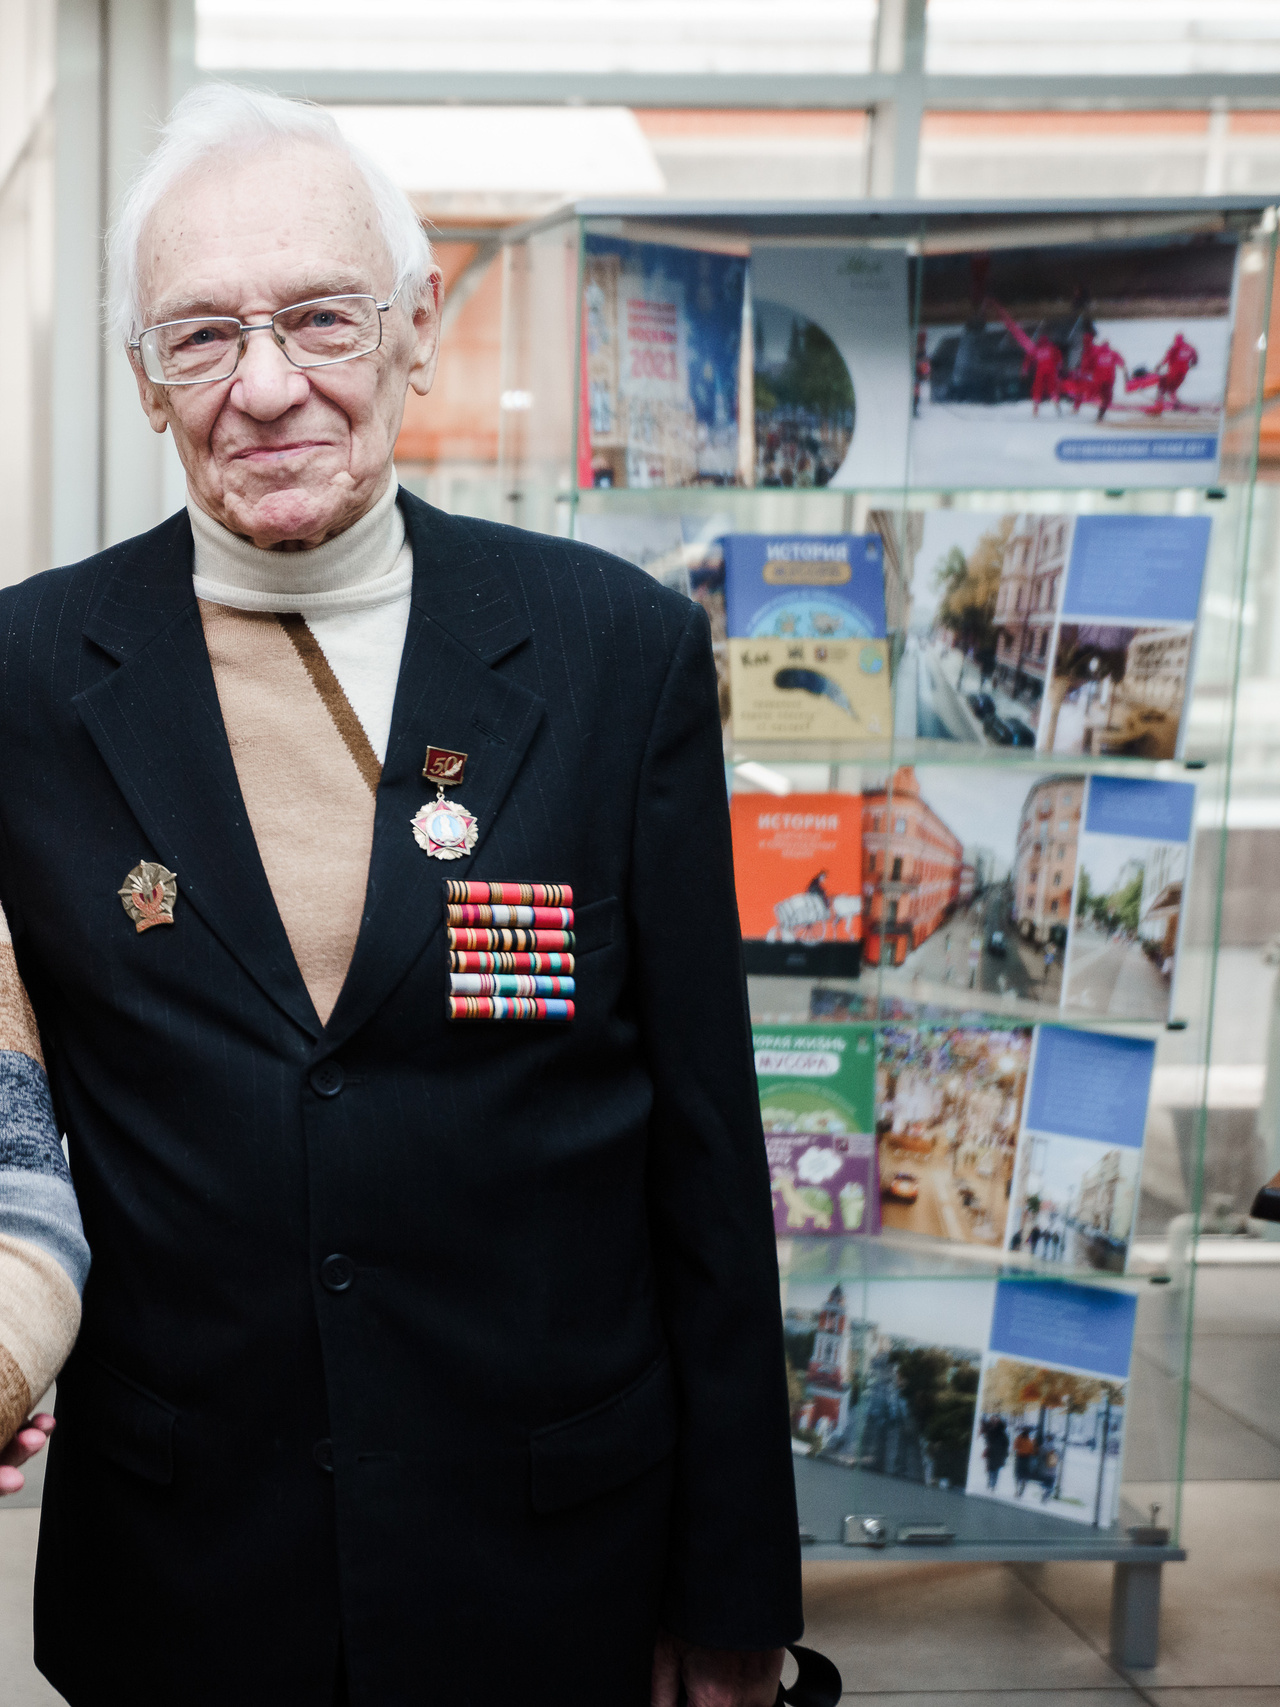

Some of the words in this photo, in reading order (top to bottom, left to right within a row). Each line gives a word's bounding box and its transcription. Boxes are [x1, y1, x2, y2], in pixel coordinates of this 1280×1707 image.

[629, 349, 678, 381] 2021
[766, 543, 848, 561] ИСТОРИЯ
[430, 756, 458, 774] 50
[758, 813, 838, 831] ИСТОРИЯ
